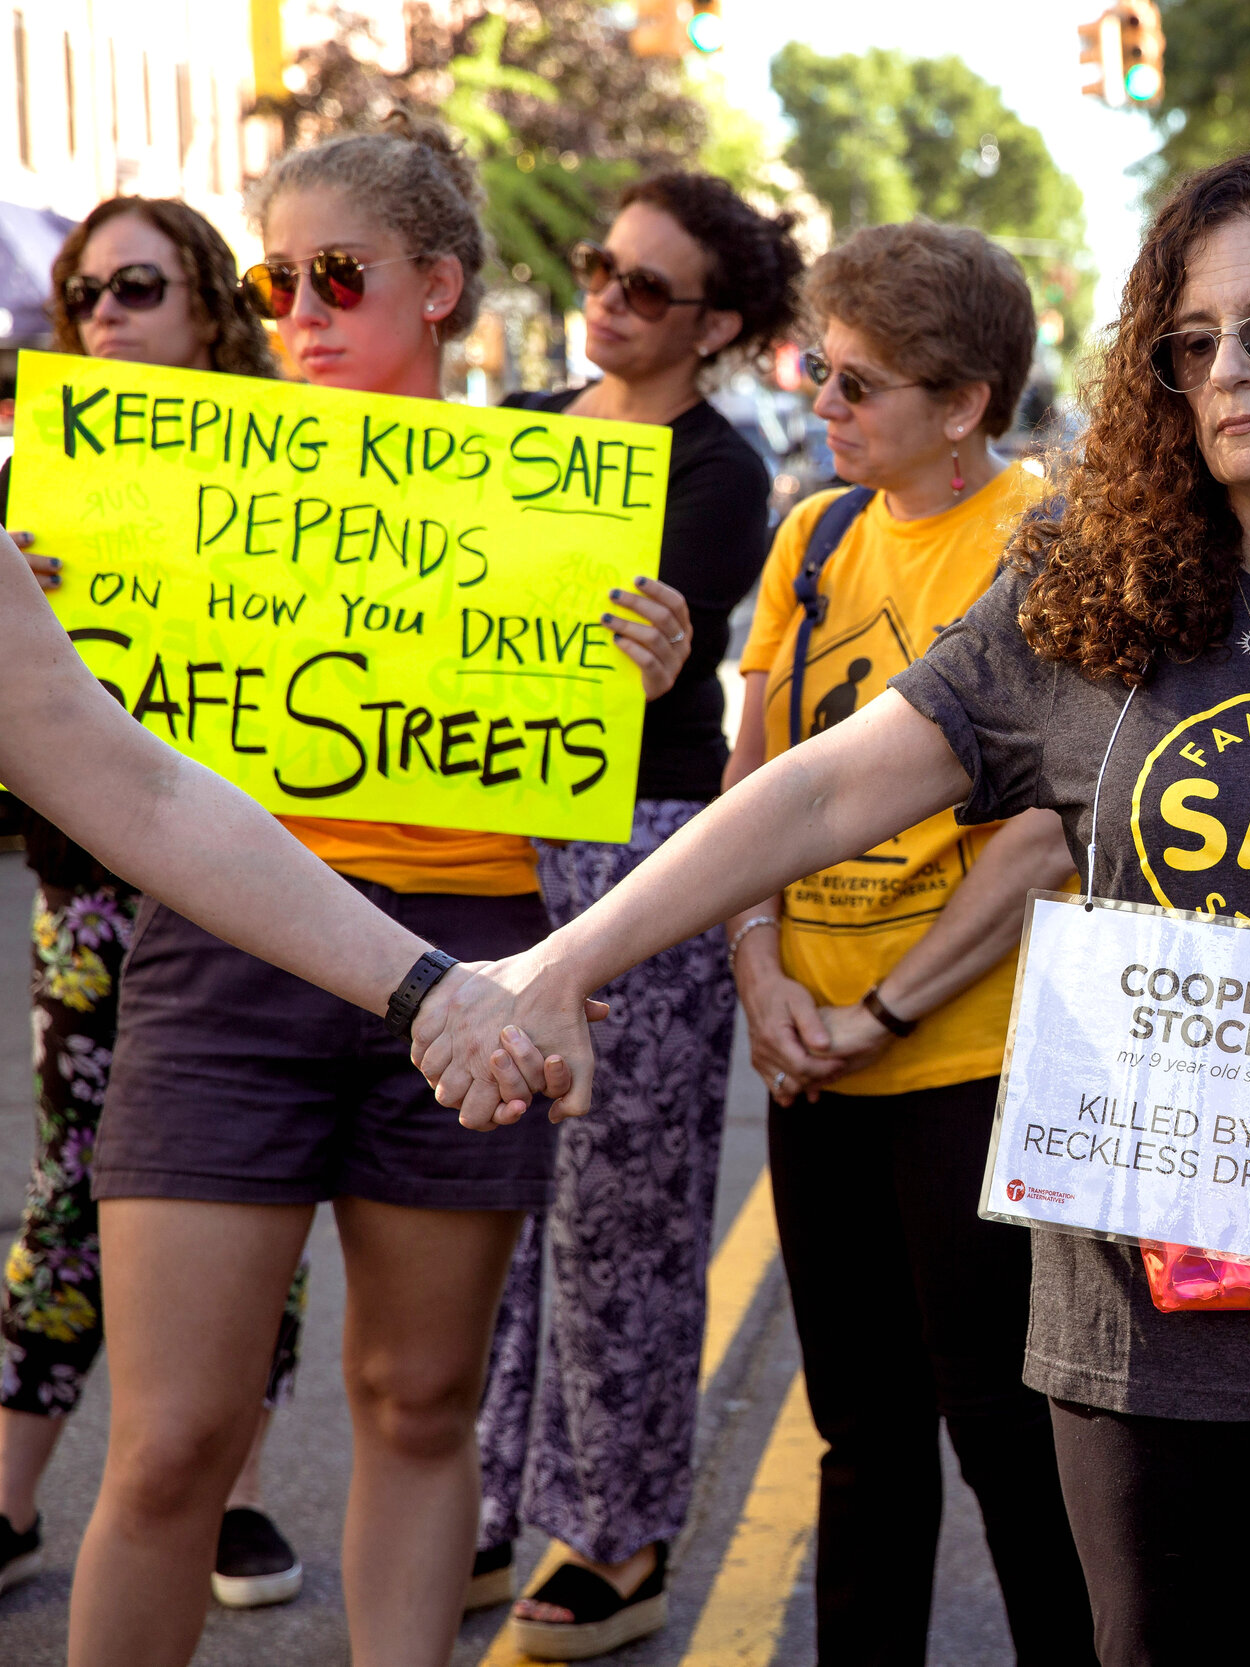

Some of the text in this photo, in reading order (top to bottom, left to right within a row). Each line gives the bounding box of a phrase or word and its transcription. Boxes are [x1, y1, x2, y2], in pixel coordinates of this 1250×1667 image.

[62, 385, 329, 474] KEEPING
[360, 416, 491, 487] KIDS
[510, 426, 656, 510] SAFE
[196, 485, 488, 588] DEPENDS
[90, 573, 162, 609] ON
[208, 583, 306, 627] HOW
[461, 608, 616, 670] DRIVE
[273, 651, 609, 801] STREETS
[1116, 1049, 1145, 1068] my
[1148, 1052, 1162, 1068] 9
[1164, 1057, 1205, 1075] year
[1209, 1063, 1242, 1080] old
[1077, 1093, 1199, 1138] KILLED
[1023, 1123, 1199, 1178] RECKLESS
[1026, 1193, 1065, 1205] ALTERNATIVES
[1027, 1186, 1076, 1200] TRANSPORTATION
